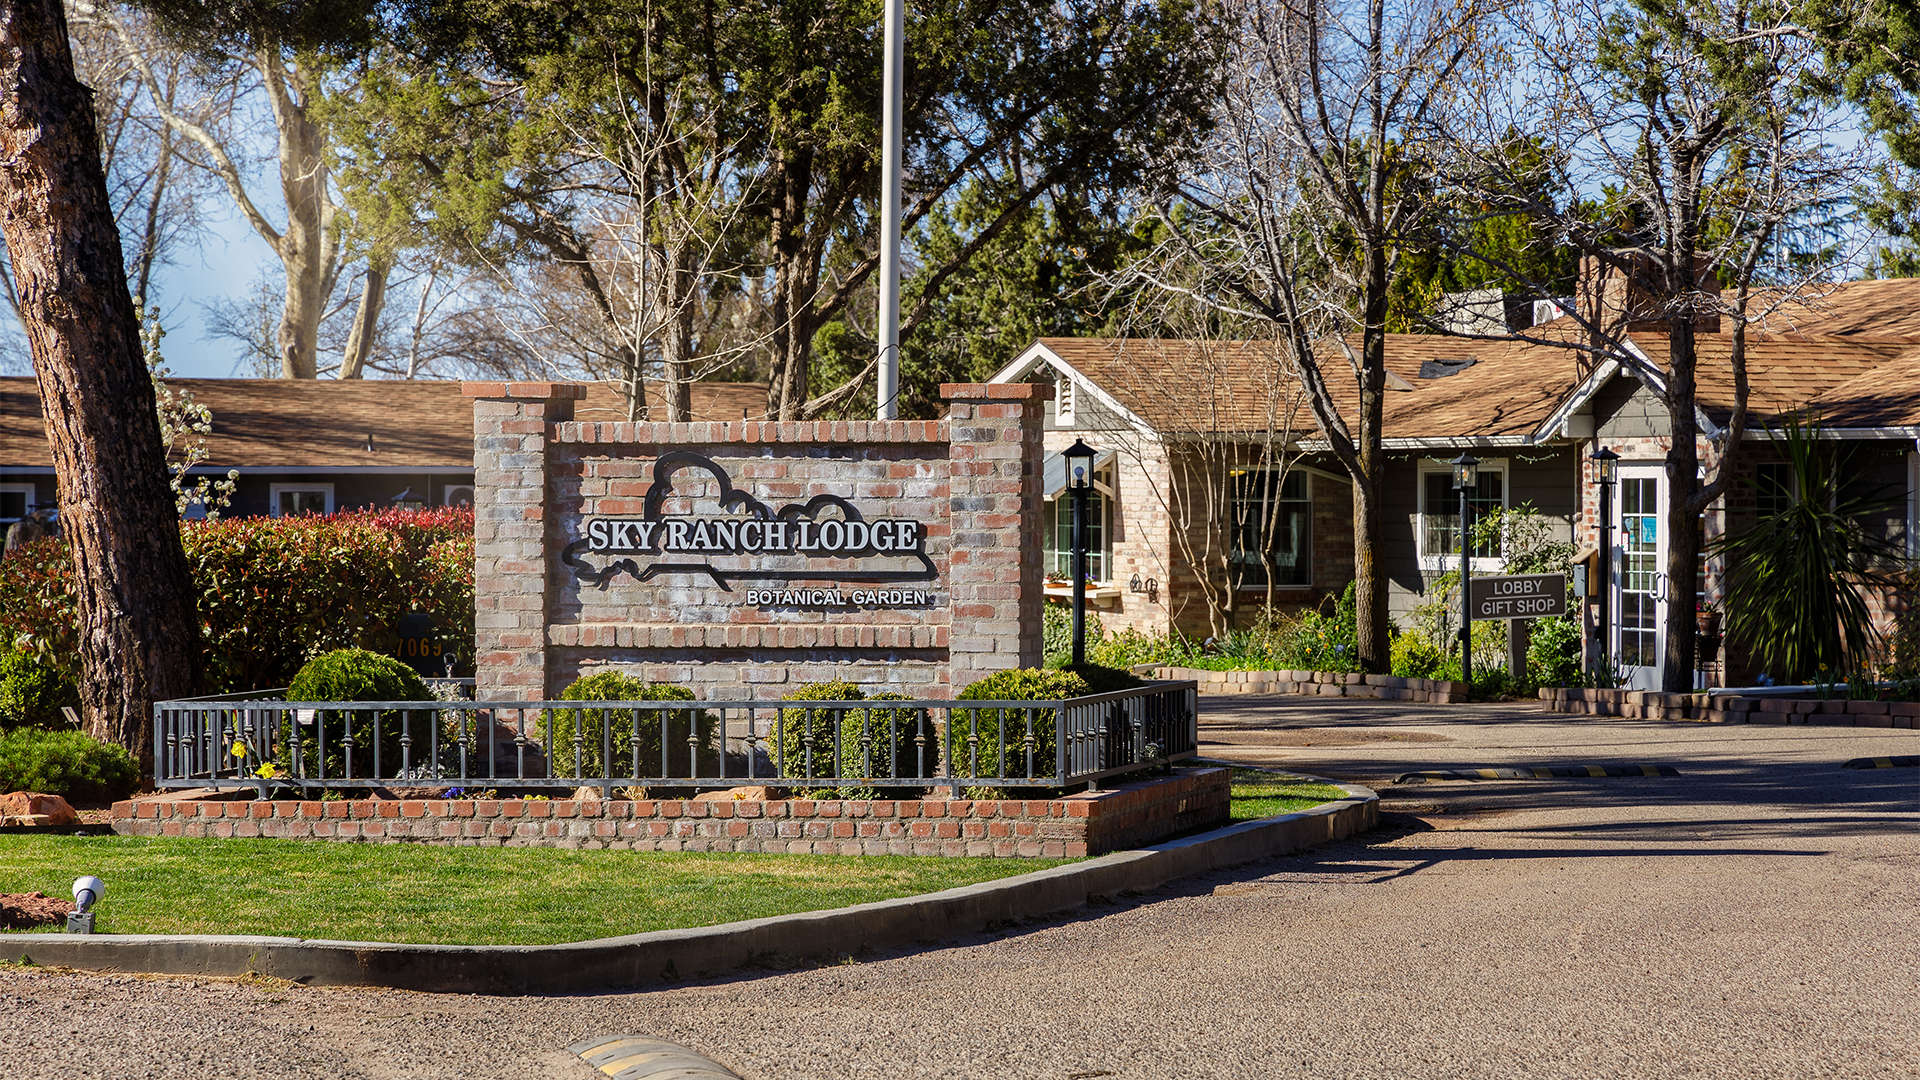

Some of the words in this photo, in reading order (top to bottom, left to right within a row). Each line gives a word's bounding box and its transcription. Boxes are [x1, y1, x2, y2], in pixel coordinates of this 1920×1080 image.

[588, 520, 657, 550] SKY
[666, 520, 788, 550] RANCH
[798, 520, 918, 550] LODGE
[1494, 580, 1543, 595] LOBBY
[747, 590, 847, 605] BOTANICAL
[852, 590, 926, 605] GARDEN
[1481, 601, 1513, 615] GIFT
[1516, 598, 1556, 613] SHOP
